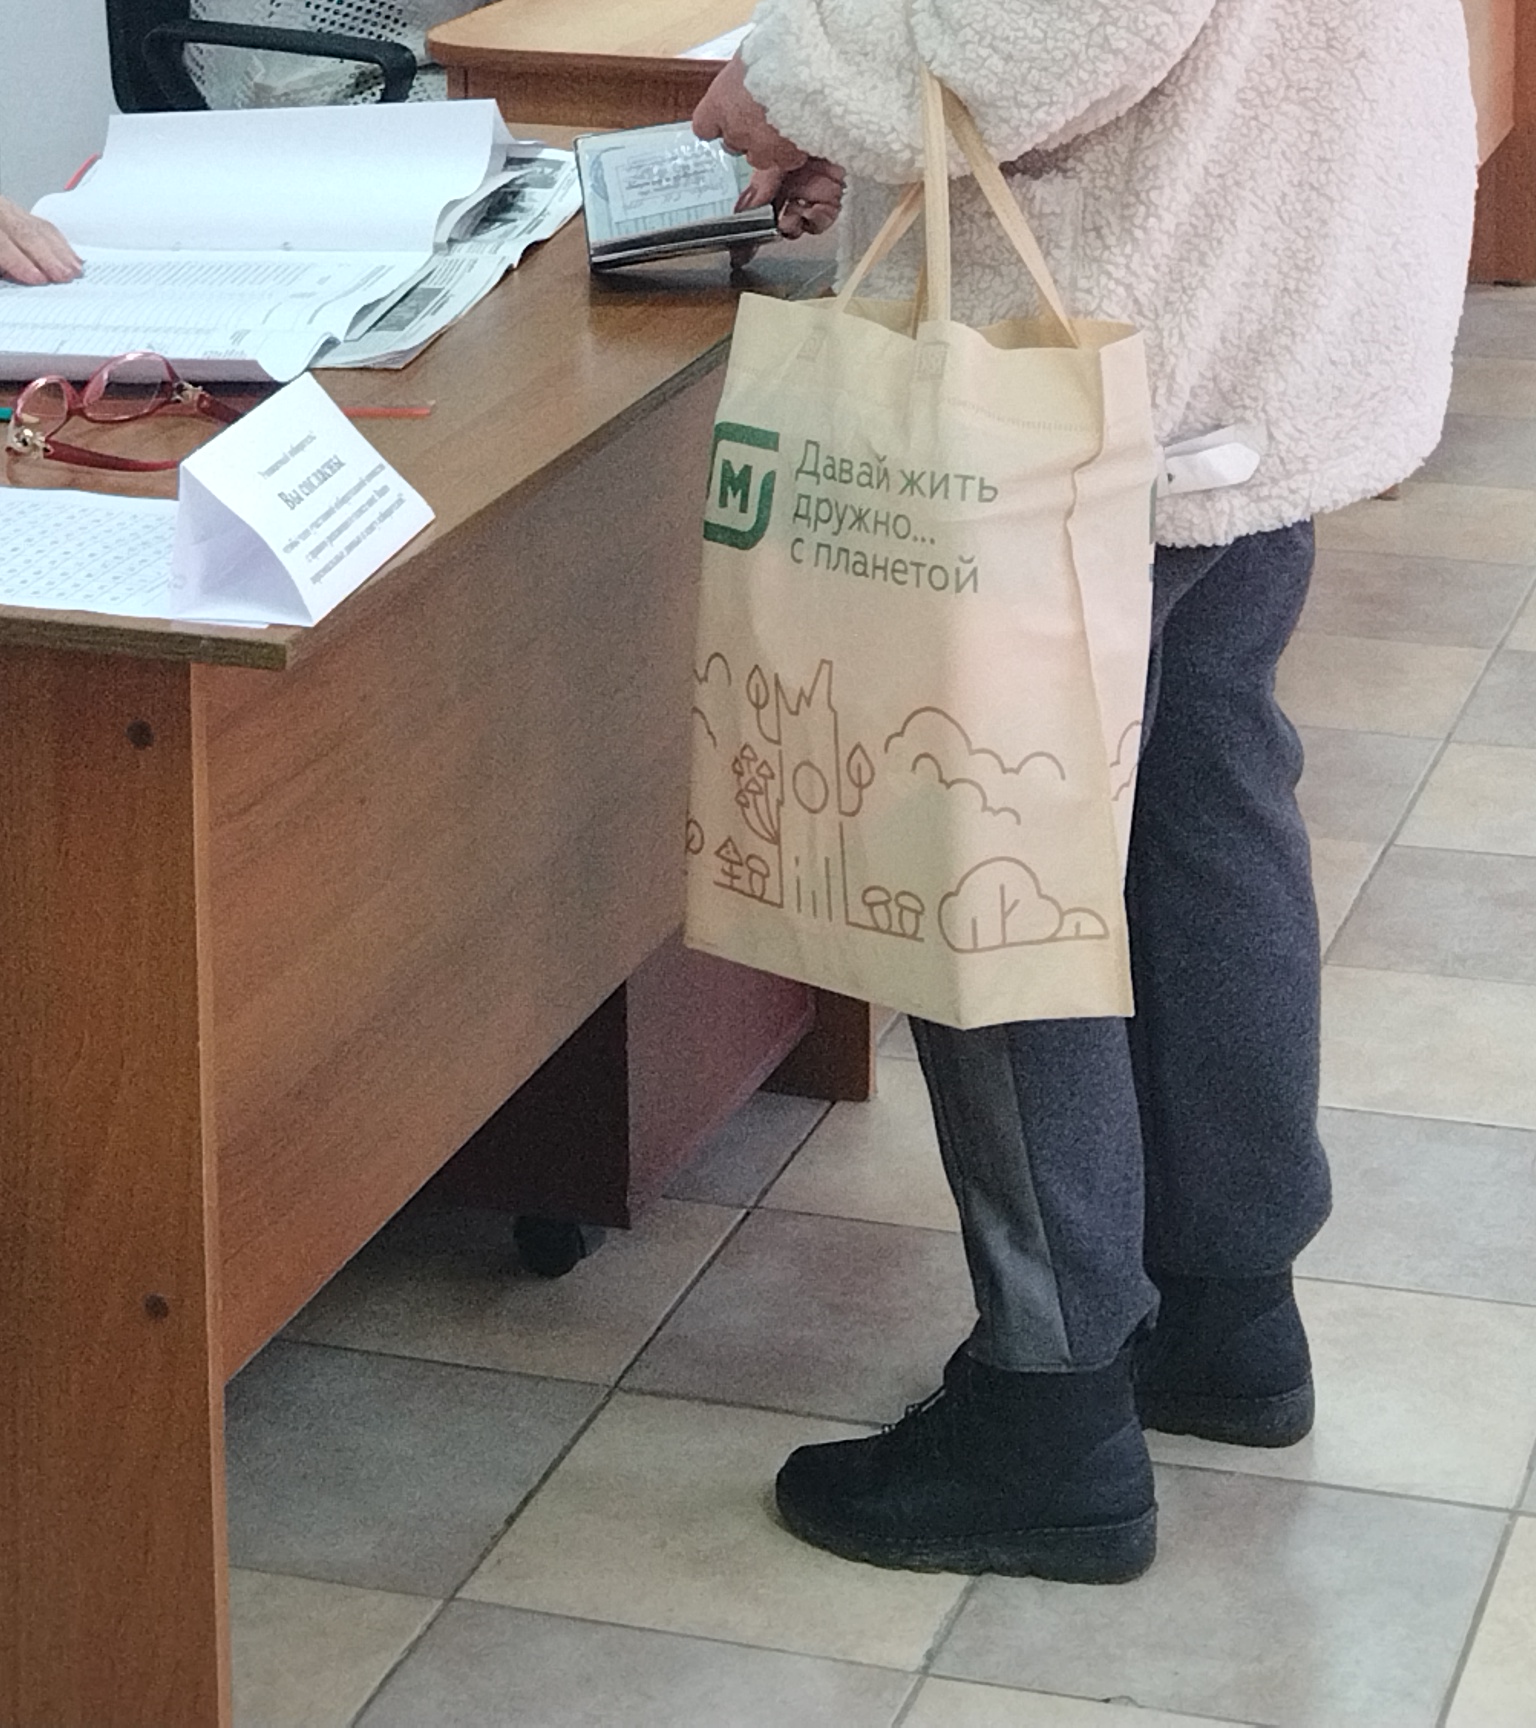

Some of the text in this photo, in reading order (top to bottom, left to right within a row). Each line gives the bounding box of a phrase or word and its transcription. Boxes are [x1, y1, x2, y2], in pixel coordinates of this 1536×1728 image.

[795, 439, 999, 503] Давай жить
[792, 492, 936, 545] дружно...
[790, 537, 980, 594] с планетой
